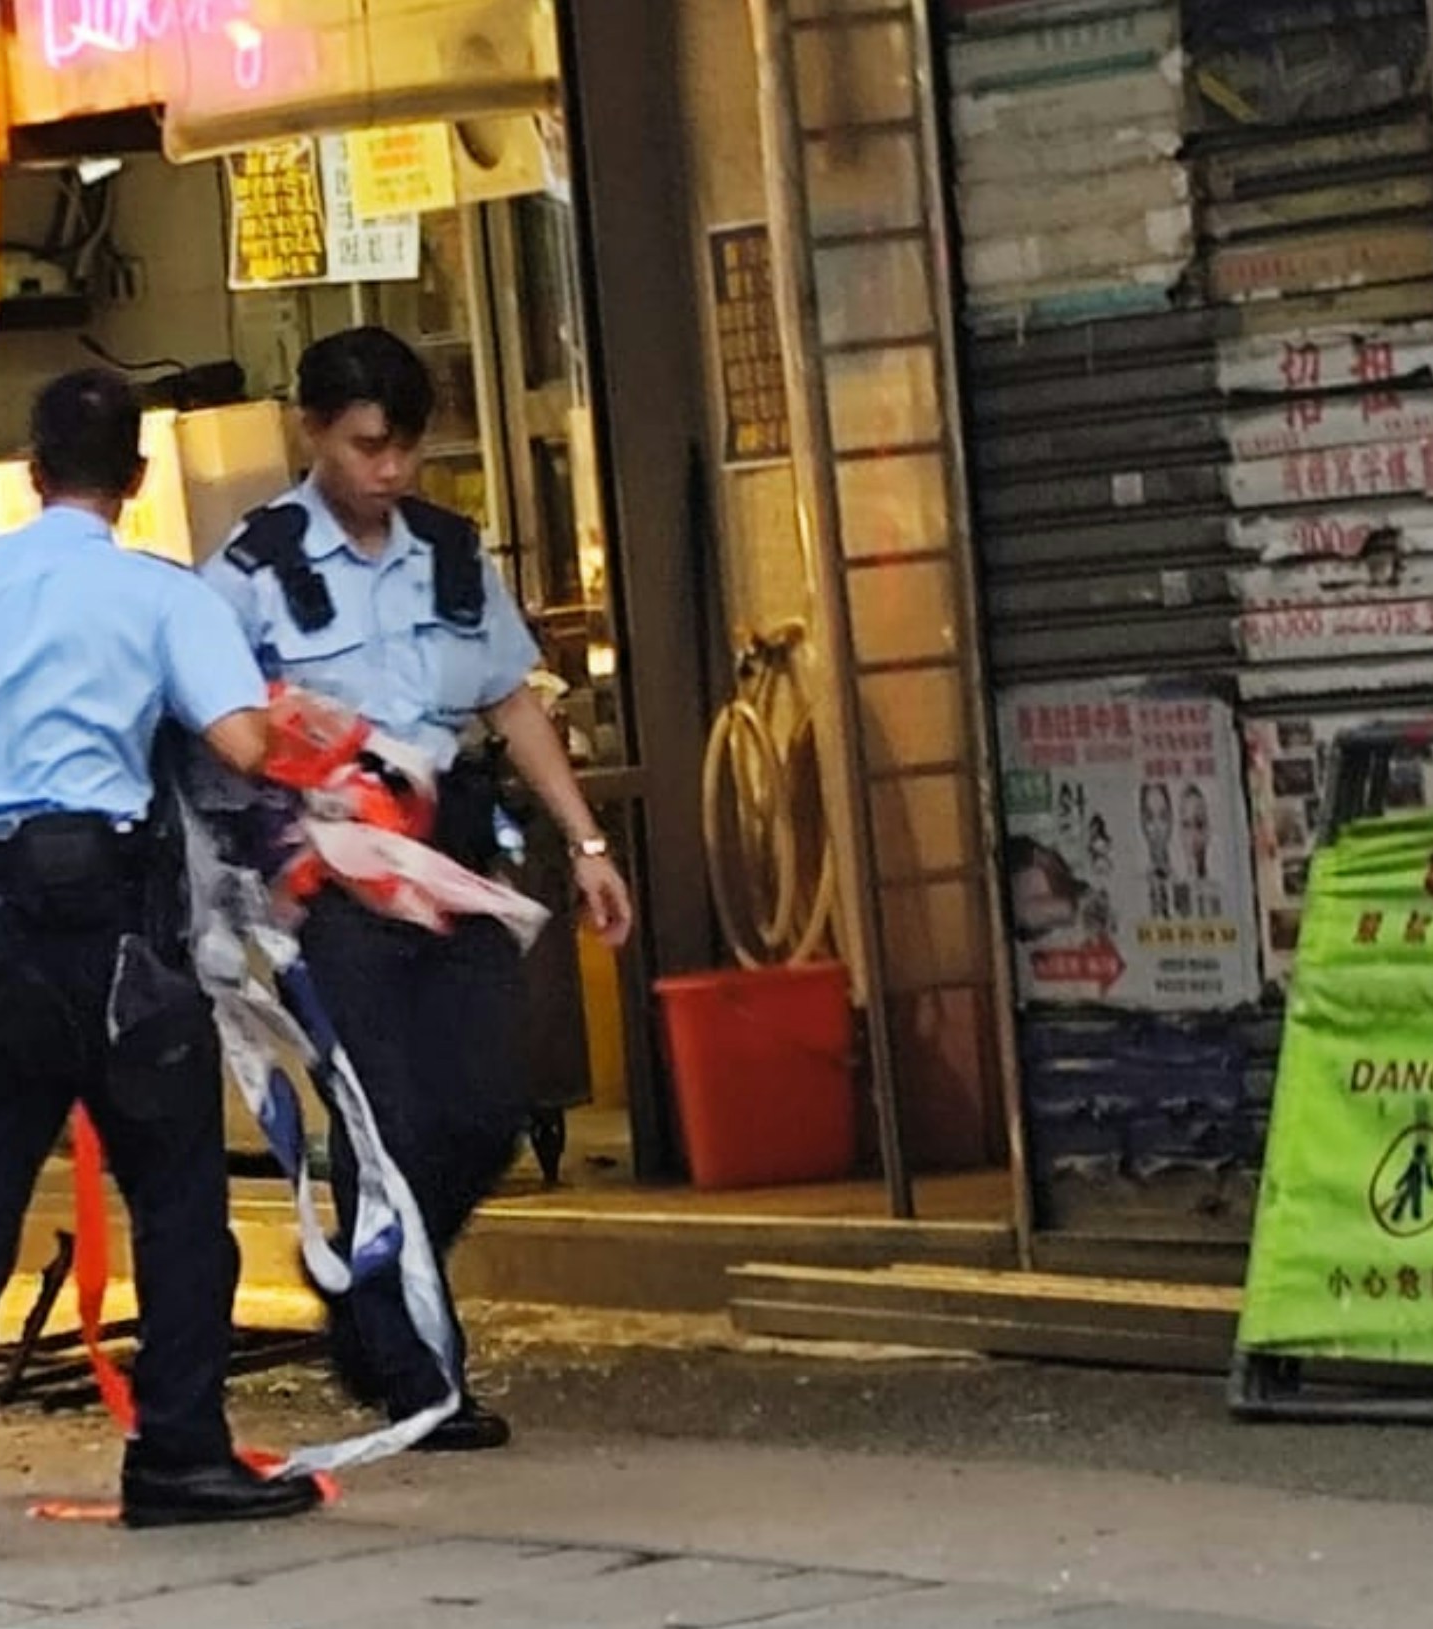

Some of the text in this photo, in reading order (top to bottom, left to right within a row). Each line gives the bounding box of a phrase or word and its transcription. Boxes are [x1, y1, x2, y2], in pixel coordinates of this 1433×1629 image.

[1350, 1058, 1433, 1093] DAN
[1327, 1264, 1433, 1302] 小心危
